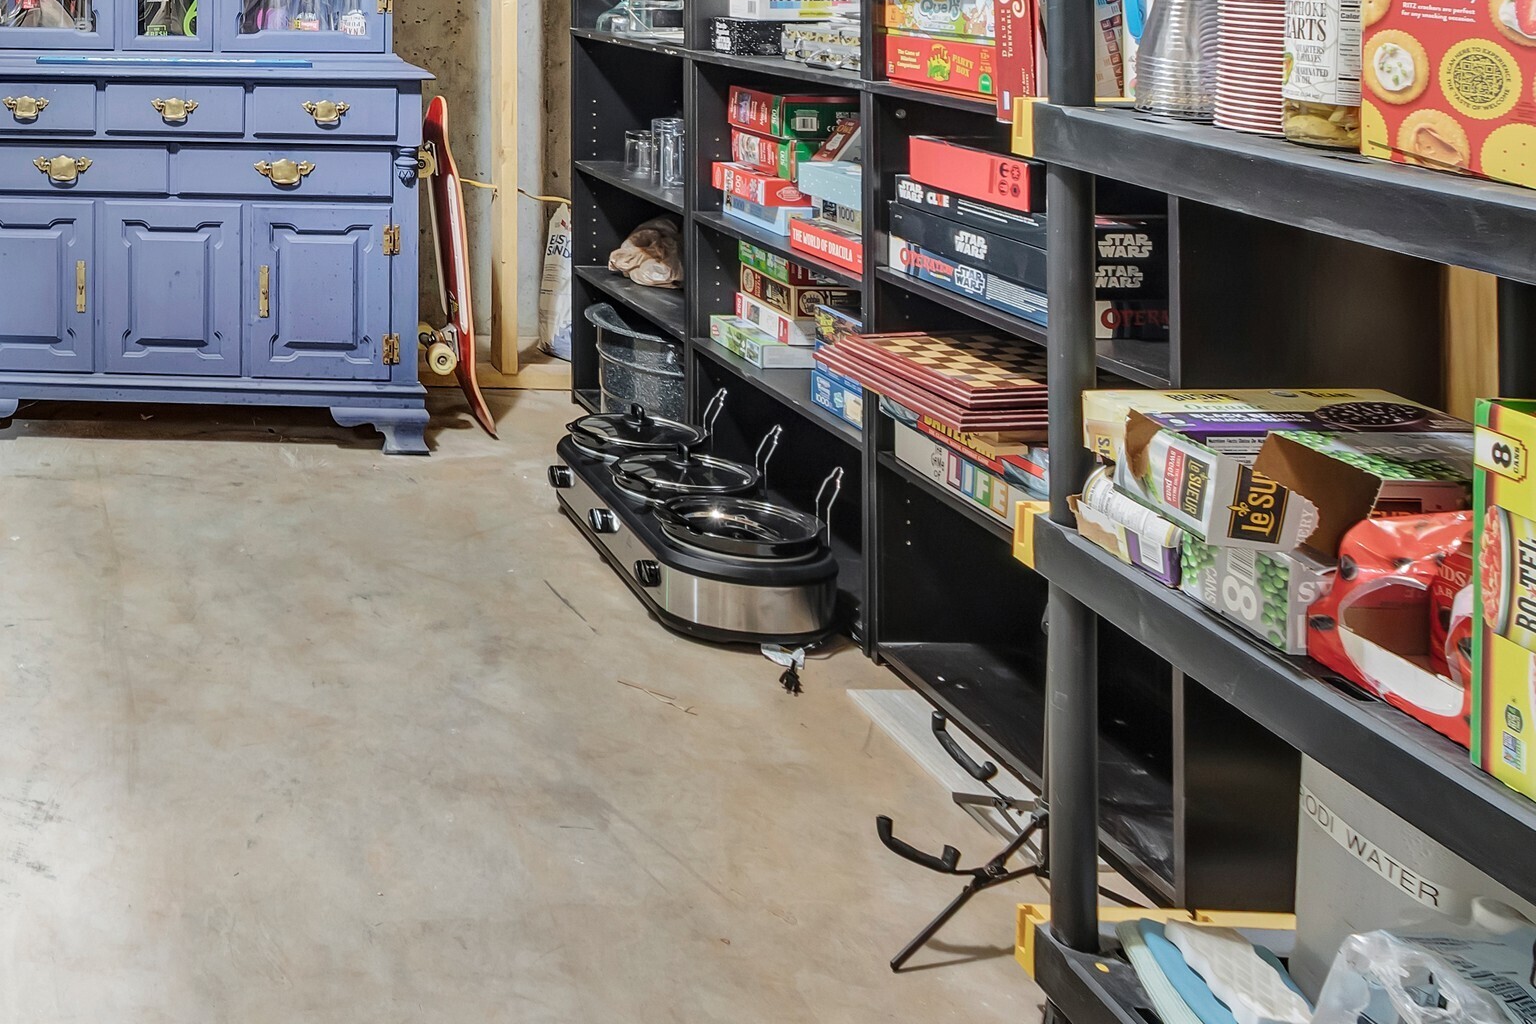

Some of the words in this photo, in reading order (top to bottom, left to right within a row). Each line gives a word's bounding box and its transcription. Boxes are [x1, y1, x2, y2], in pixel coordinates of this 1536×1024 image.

[1401, 9, 1410, 17] for
[1421, 12, 1448, 22] snacking
[1417, 3, 1442, 12] crackers
[1452, 6, 1476, 16] perfect
[1007, 8, 1015, 59] TURNTABLE
[952, 54, 974, 70] PARTY
[955, 65, 970, 78] BOX
[1446, 58, 1456, 75] SCAN
[1482, 48, 1512, 83] EXPERIENCE
[1447, 78, 1455, 92] THE
[1453, 92, 1471, 109] TASTE
[1482, 88, 1511, 110] WELCOME
[898, 179, 924, 195] STAR
[898, 188, 924, 204] WARS
[926, 191, 950, 208] CLUE
[838, 205, 855, 223] 1000
[792, 228, 803, 243] THE
[803, 232, 821, 251] WORLD
[821, 239, 829, 252] OF
[828, 242, 853, 263] DRACULA
[954, 230, 988, 251] STAR
[954, 240, 988, 261] WARS
[1098, 233, 1153, 246] STAR
[899, 247, 955, 277] OPERATION
[1098, 245, 1153, 258] WARS
[954, 264, 985, 283] STAR
[1094, 265, 1144, 277] STAR
[954, 274, 986, 295] WARS
[1167, 450, 1177, 478] sweet
[1491, 441, 1512, 466] 8
[1513, 446, 1522, 475] CANS
[947, 452, 1008, 517] LIFE
[1164, 477, 1174, 502] peas
[1183, 472, 1202, 517] SUEUR
[1241, 510, 1275, 537] Le
[1204, 566, 1218, 605] CANS
[1222, 575, 1258, 621] 8
[1346, 828, 1441, 908] WATER
